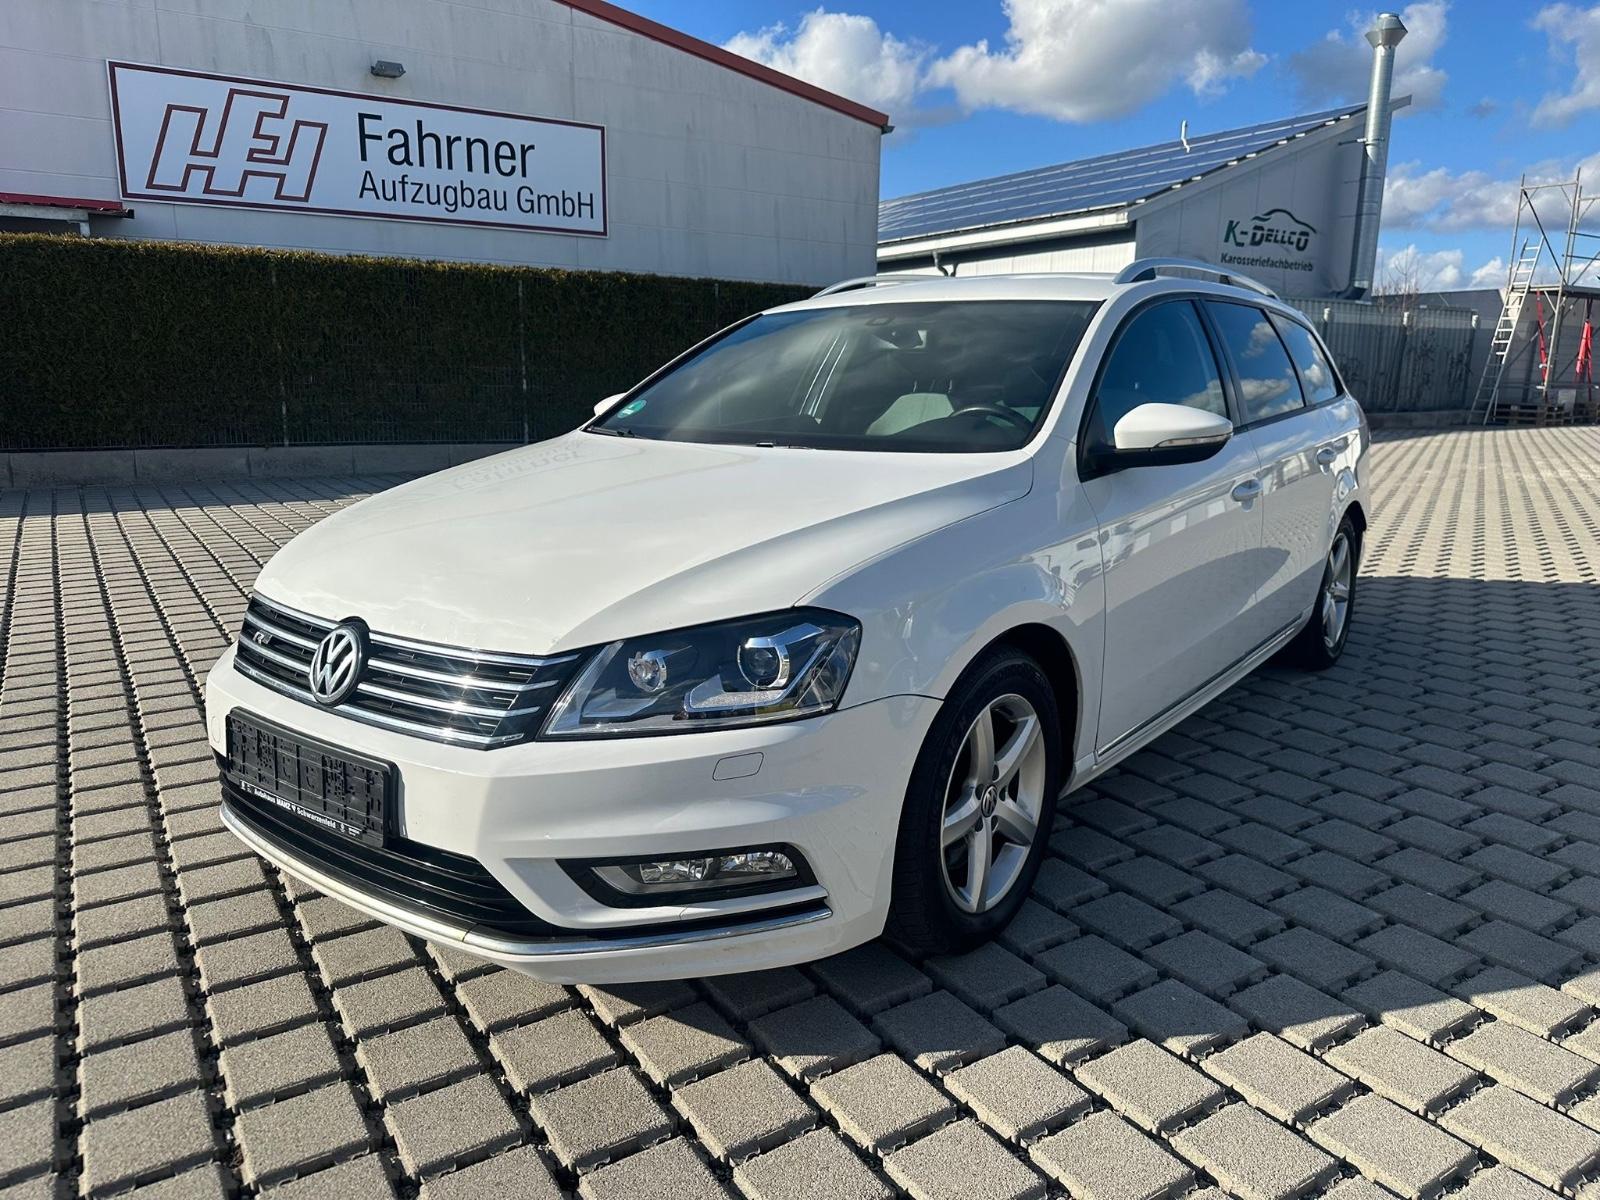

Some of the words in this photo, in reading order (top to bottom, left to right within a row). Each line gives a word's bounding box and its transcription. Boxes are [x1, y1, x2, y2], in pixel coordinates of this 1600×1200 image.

[358, 112, 536, 179] Fahrner
[358, 170, 508, 213] Aufzugbau
[516, 185, 595, 220] GmbH
[1220, 252, 1314, 272] Karosseriefachbetrieb
